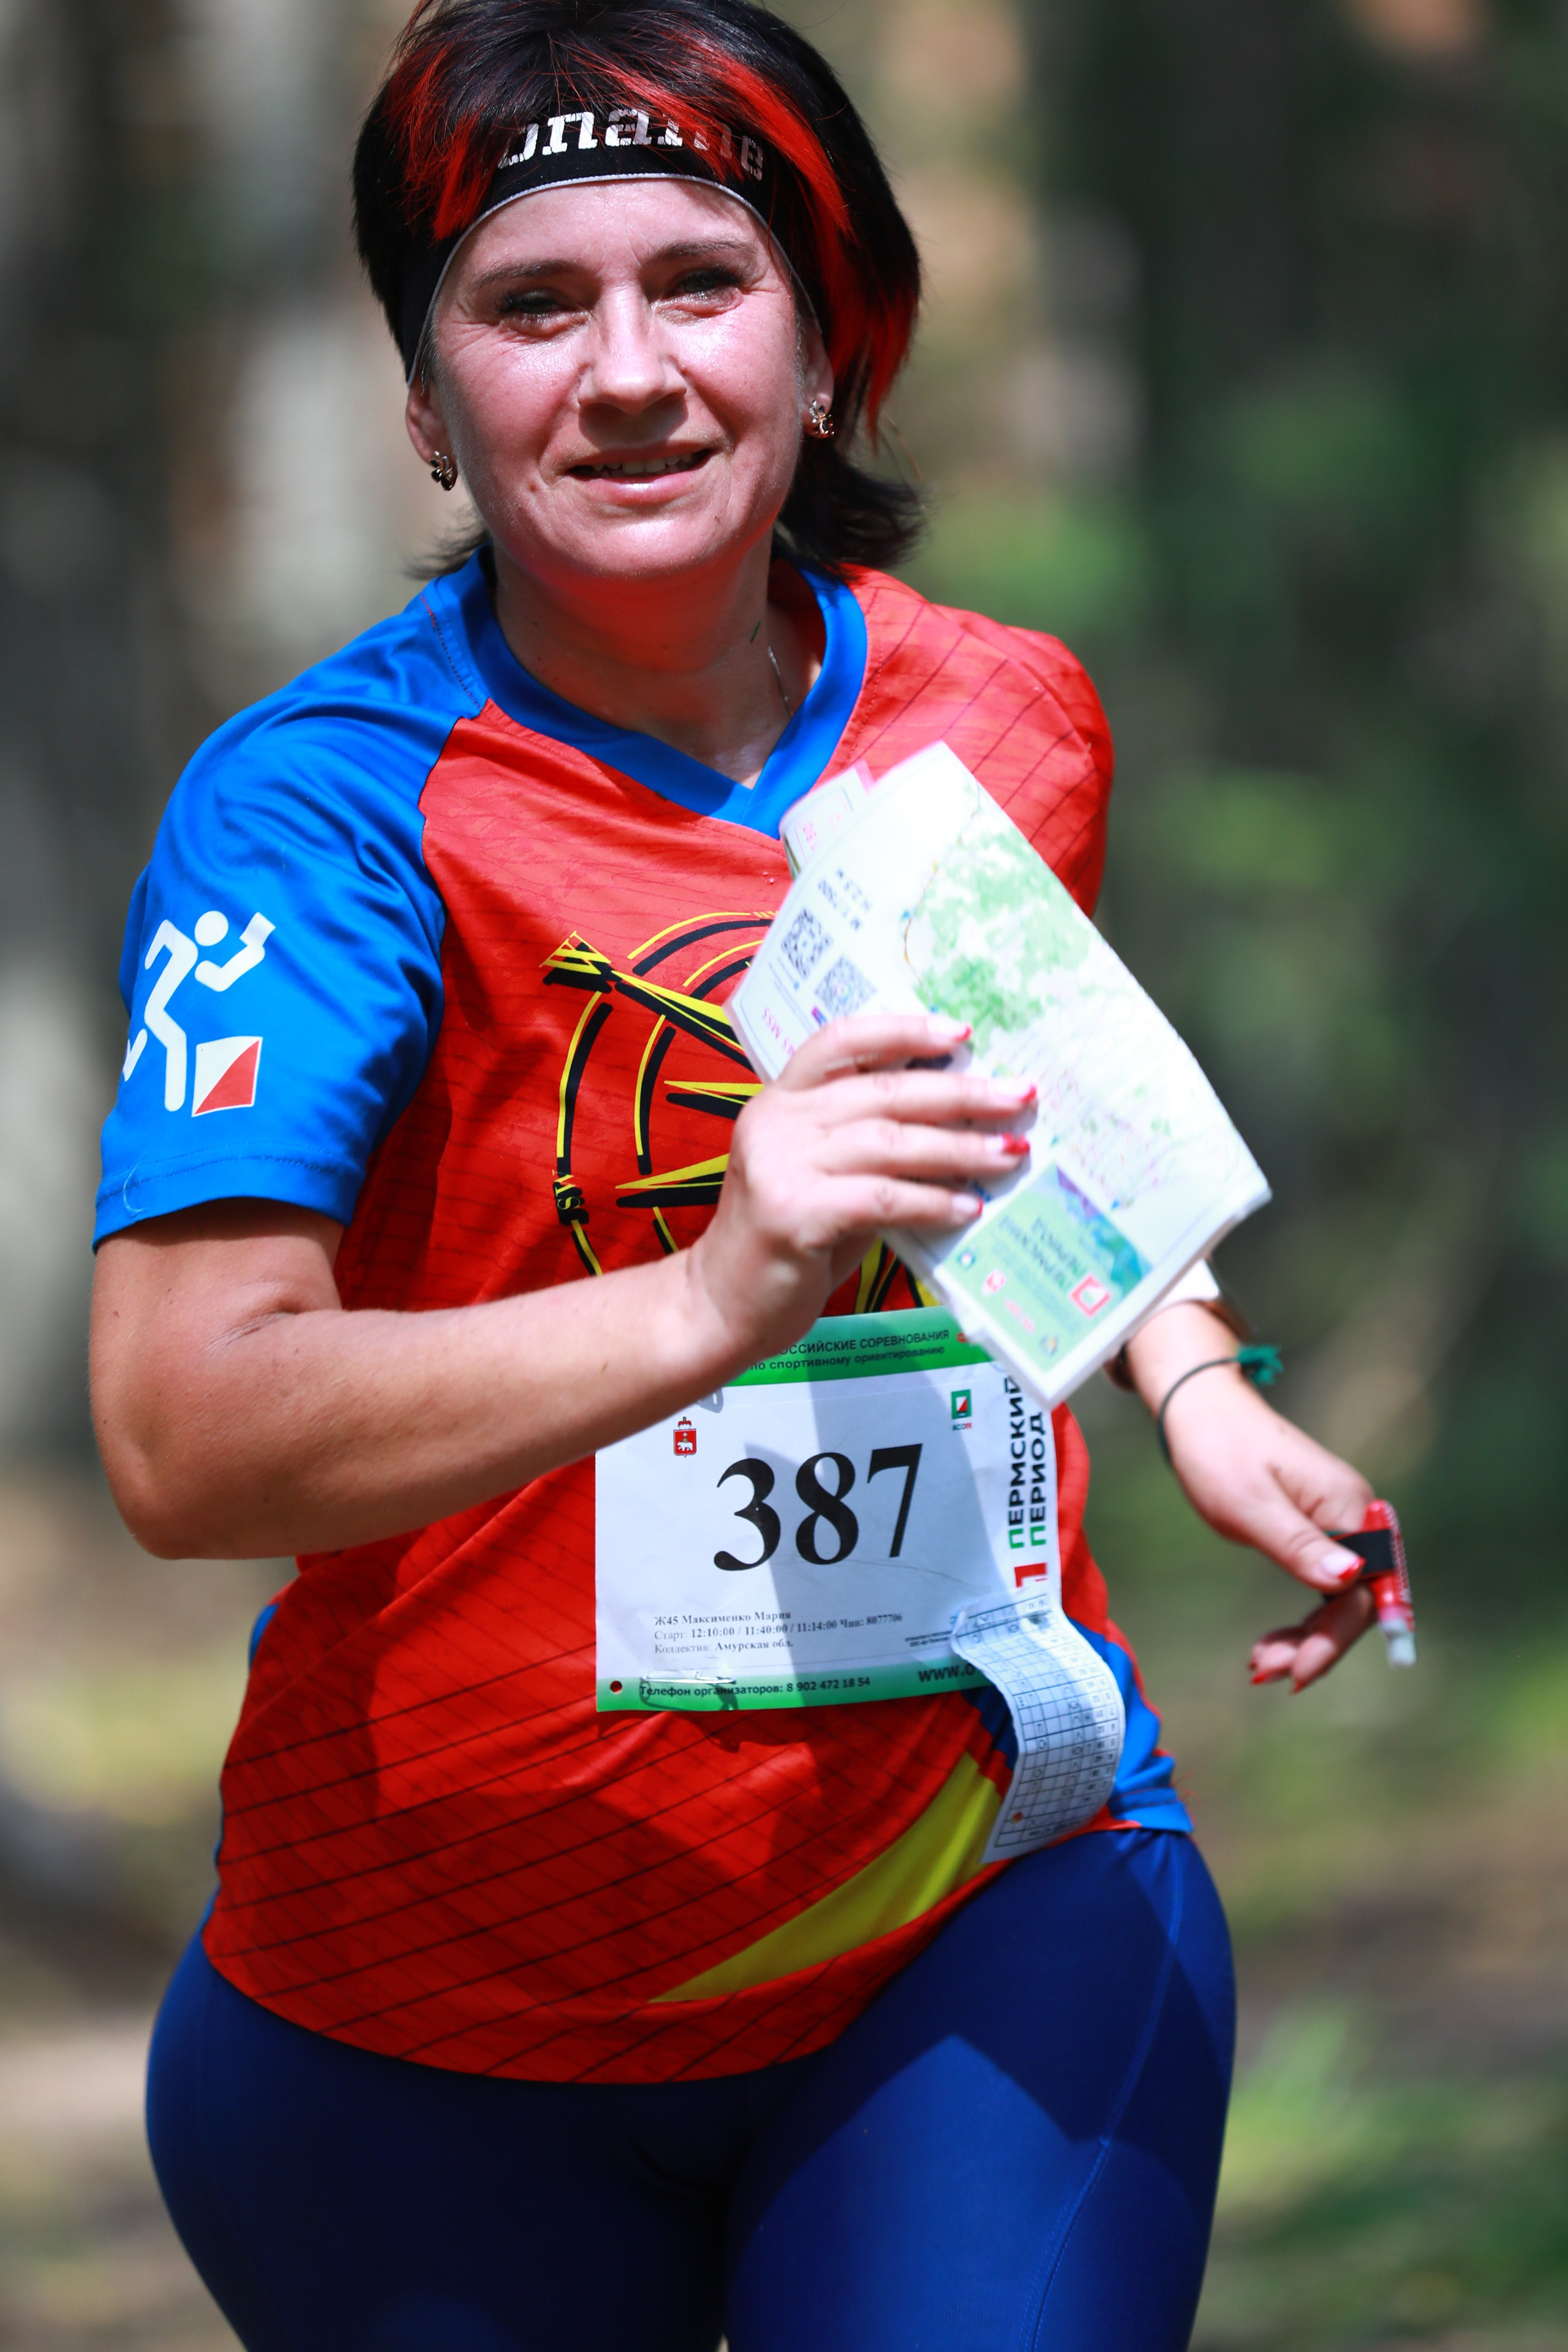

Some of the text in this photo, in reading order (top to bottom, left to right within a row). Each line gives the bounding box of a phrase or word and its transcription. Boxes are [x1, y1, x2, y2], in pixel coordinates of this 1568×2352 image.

[860, 1330, 949, 1349] СОРЕВНОВАНИЯ
[770, 1356, 851, 1370] спортивному
[854, 1347, 945, 1364] ориентированию
[1029, 1411, 1046, 1547] ПЕРИОД
[714, 1443, 923, 1571] 387
[654, 1611, 791, 1626] Ж45 Максименко Мария
[654, 1630, 687, 1642] Старт:
[692, 1627, 735, 1638] 12:10:00
[745, 1624, 788, 1635] 11:40:00
[797, 1620, 837, 1632] 11:14:00
[840, 1619, 864, 1628] Чип:
[655, 1638, 794, 1654] Коллектив: Амурская обл.
[640, 1677, 871, 1698] Телефон организаторов: 8 902 472 18 54
